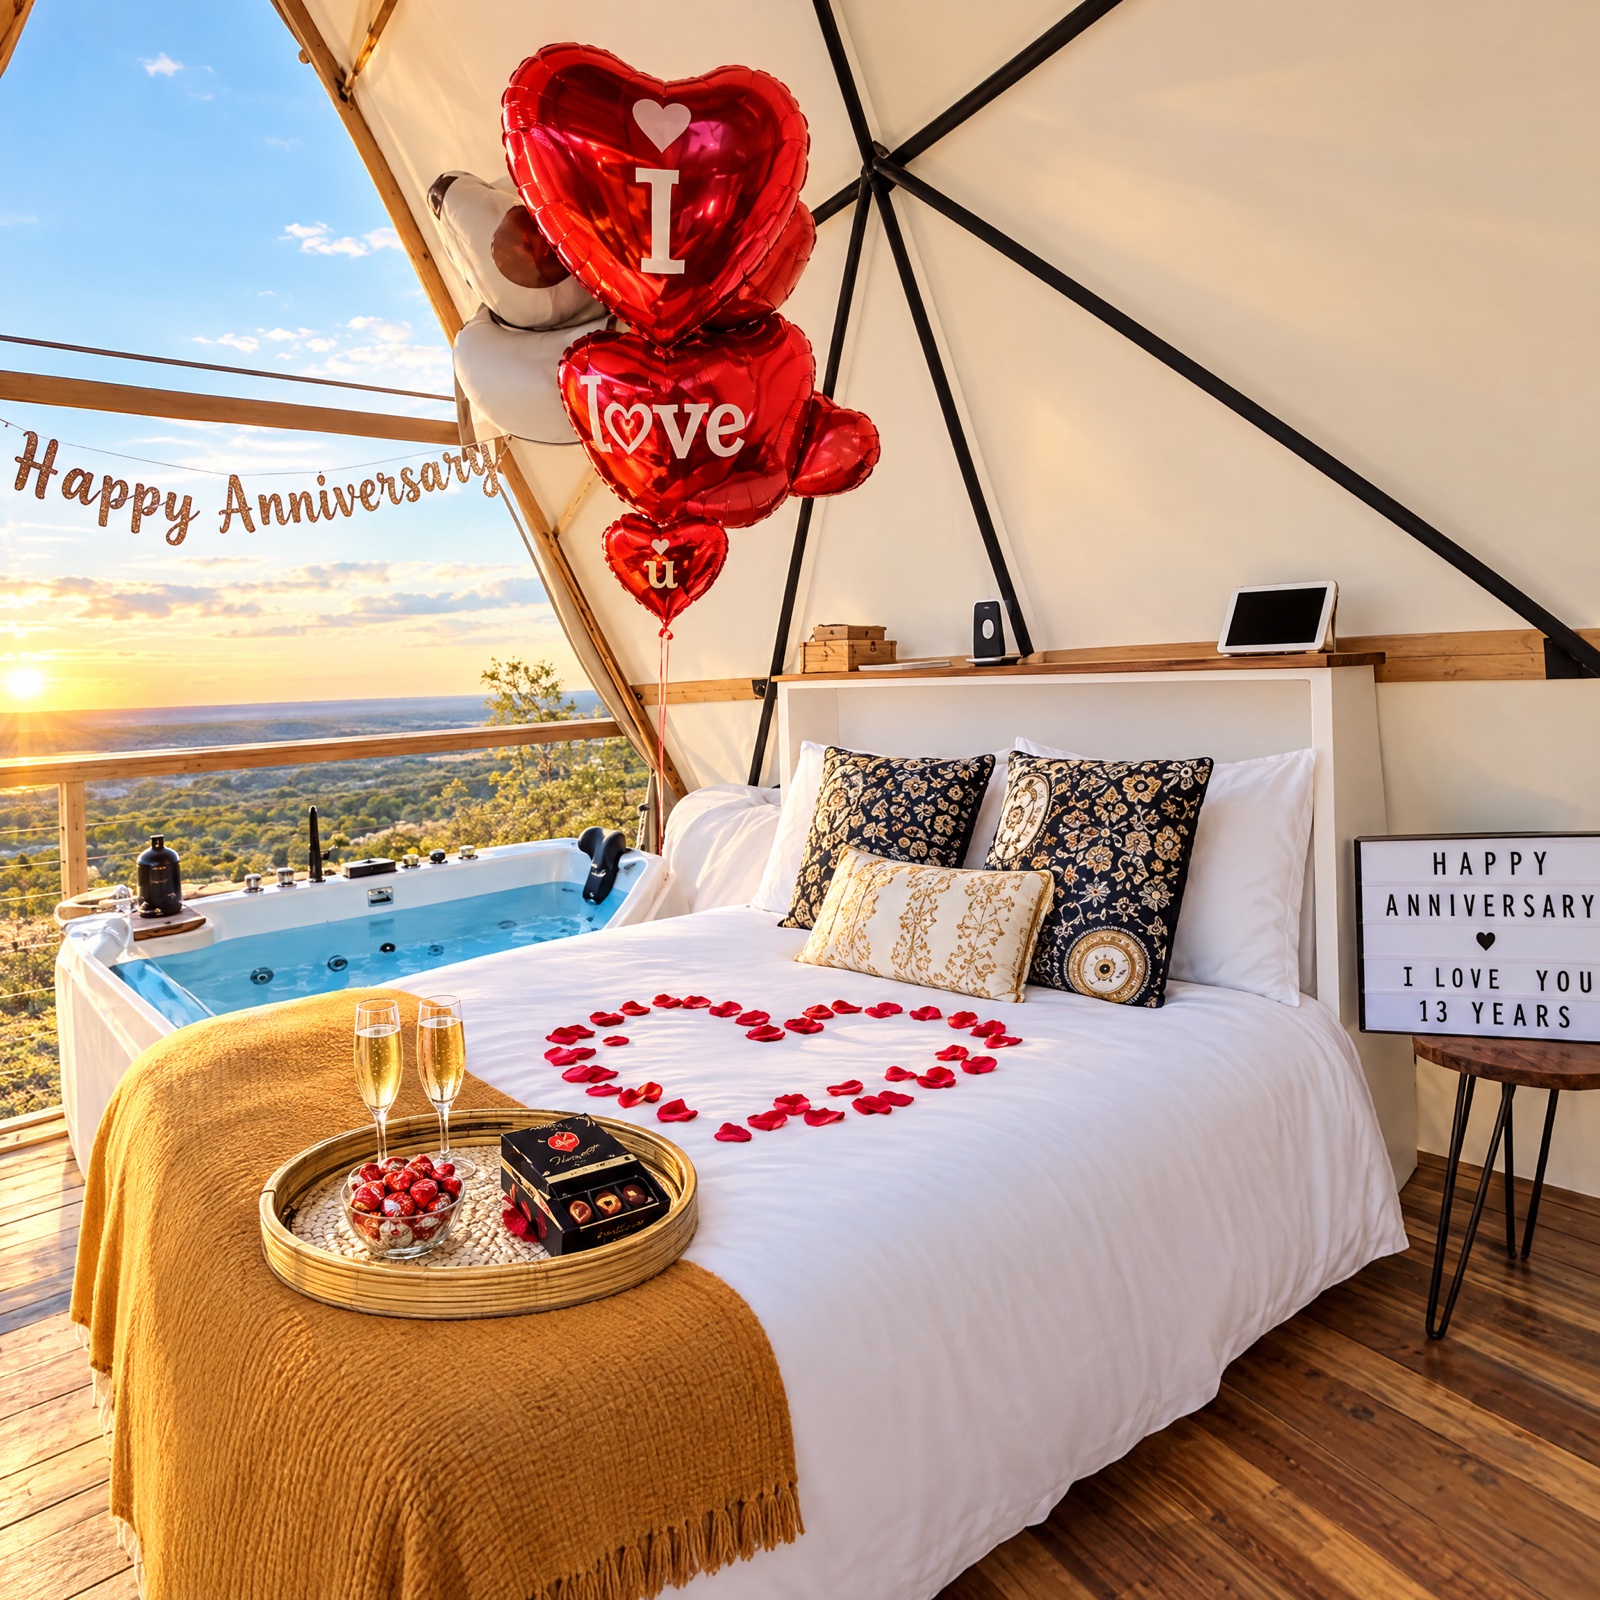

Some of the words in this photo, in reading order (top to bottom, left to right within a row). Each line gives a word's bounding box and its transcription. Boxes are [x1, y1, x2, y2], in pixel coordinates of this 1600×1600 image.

[635, 168, 685, 274] I
[14, 431, 200, 546] Happy
[219, 443, 501, 534] Anniversary
[1433, 851, 1547, 875] HAPPY
[1386, 893, 1594, 918] ANNIVERSARY
[1403, 966, 1413, 987] I
[1435, 967, 1500, 990] LOVE
[1536, 969, 1593, 994] YOU
[1419, 999, 1448, 1023] 13
[1471, 1001, 1571, 1029] YEARS
